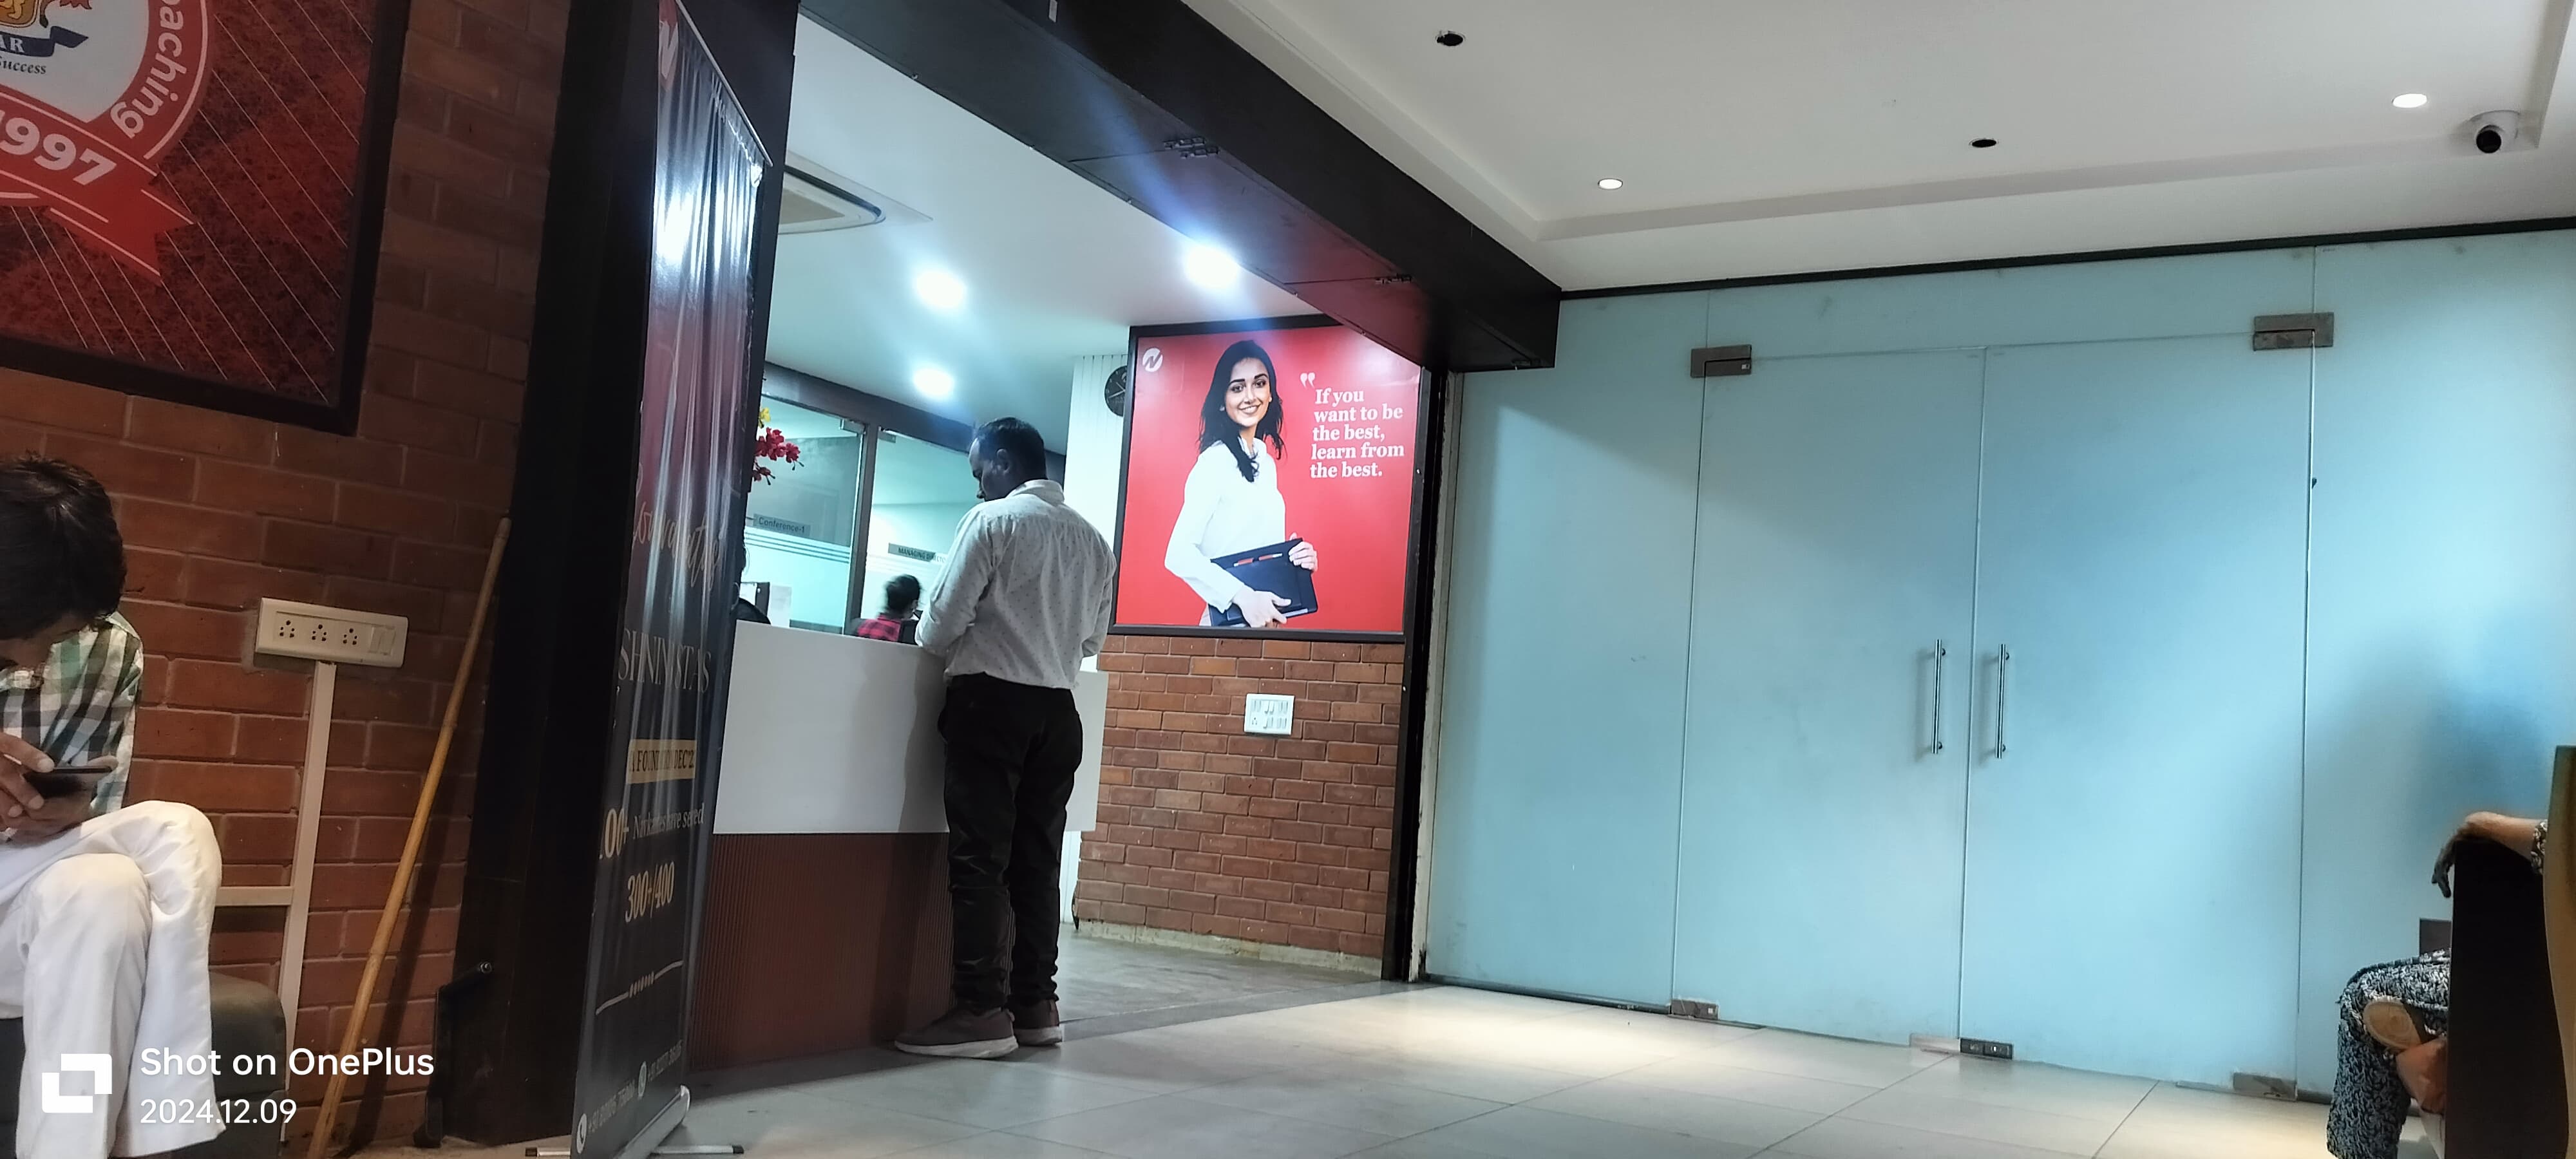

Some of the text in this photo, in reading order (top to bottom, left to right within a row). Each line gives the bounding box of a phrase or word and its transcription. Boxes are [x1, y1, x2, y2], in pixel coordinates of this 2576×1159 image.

[110, 0, 187, 138] aching
[0, 109, 117, 185] 997
[1314, 388, 1364, 407] If you
[1314, 403, 1403, 422] want to be
[1312, 424, 1385, 442] the best,
[1311, 442, 1404, 460] learn from
[1310, 461, 1383, 478] the best.
[759, 517, 805, 533] Conference-1
[898, 547, 925, 559] MANAGING
[595, 807, 629, 860] 00+
[625, 861, 675, 923] 300+/400
